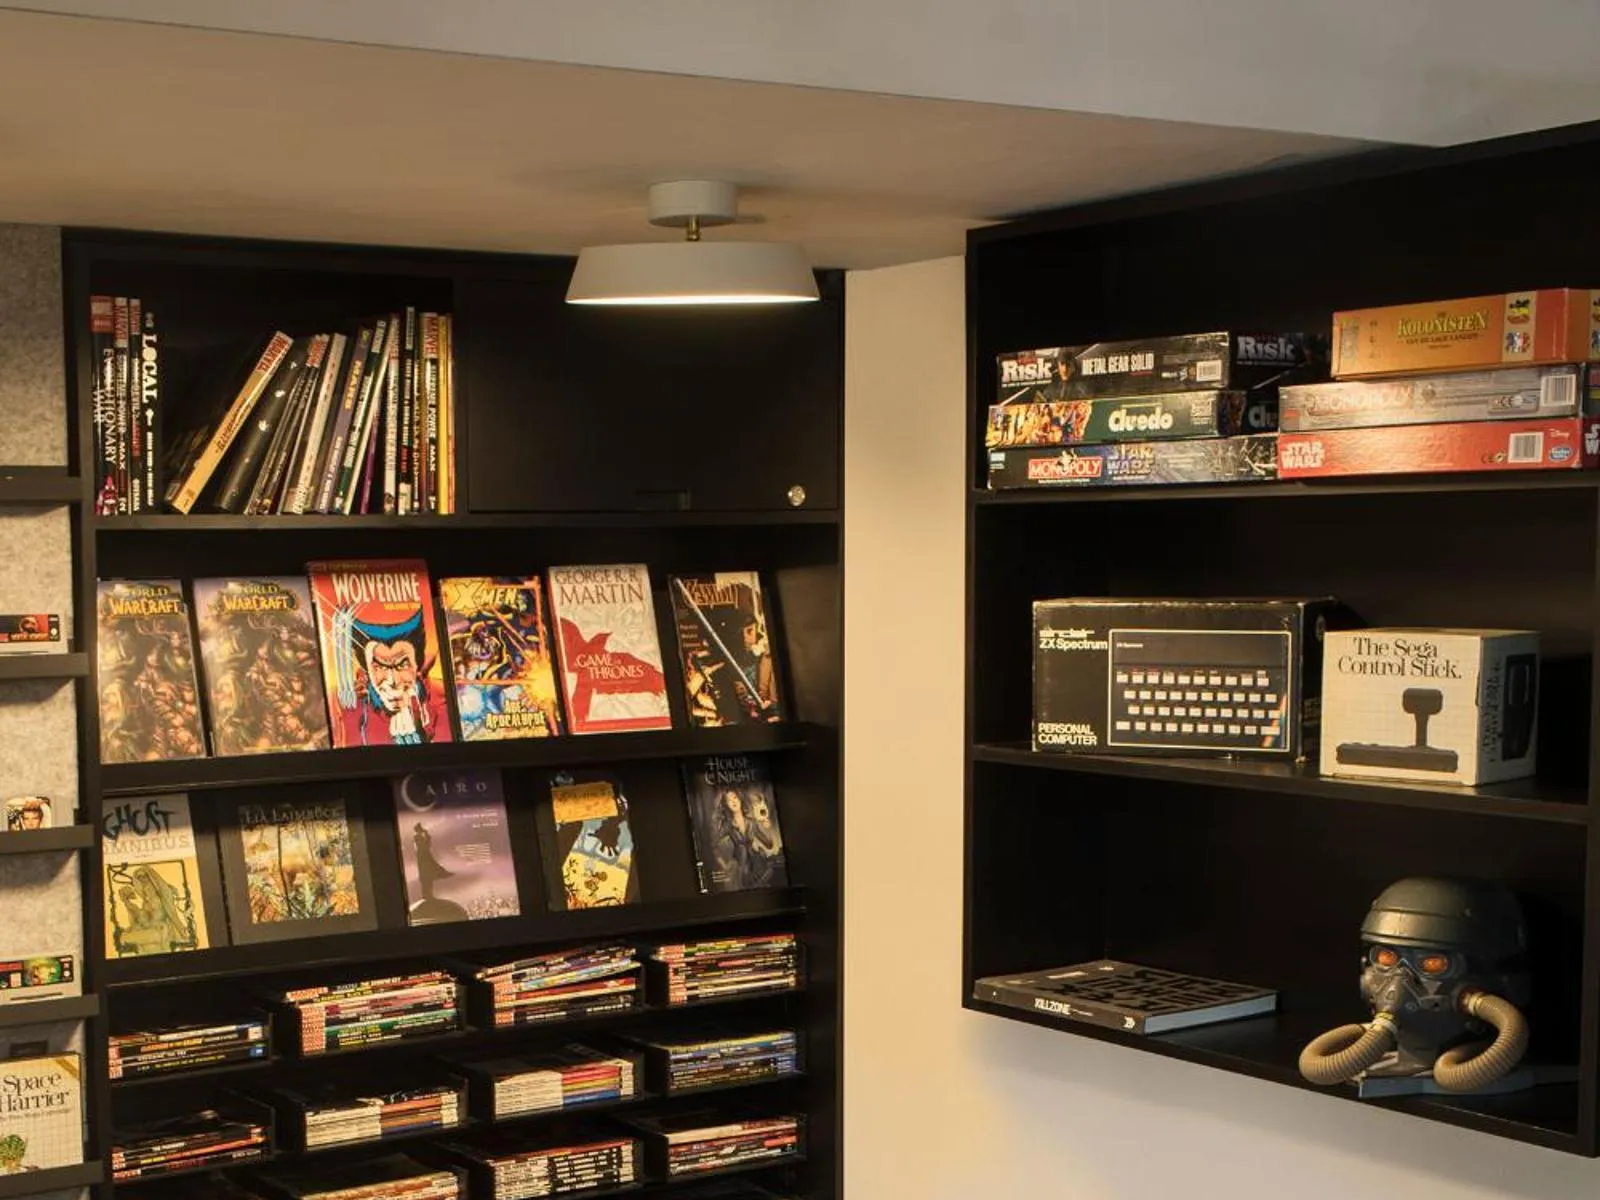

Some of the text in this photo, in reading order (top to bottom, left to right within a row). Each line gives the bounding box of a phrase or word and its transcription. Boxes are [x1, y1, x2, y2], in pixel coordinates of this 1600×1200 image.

[142, 333, 158, 403] LOCAL
[1082, 353, 1154, 376] METAL GEAR SOLID
[1108, 406, 1174, 433] Cluedo
[1287, 441, 1324, 455] STAR
[1029, 458, 1102, 478] MONOPOLY
[1281, 452, 1326, 469] WARS
[555, 570, 610, 585] GEORGE
[332, 573, 421, 607] WOLVERINE
[455, 582, 517, 611] X-MEN
[560, 583, 645, 606] MARTIN
[1039, 638, 1055, 649] ZX
[1056, 638, 1108, 651] Spectrum
[1353, 637, 1439, 660] The Sega
[576, 653, 613, 668] GAME
[1338, 656, 1406, 677] Control
[588, 665, 644, 680] THRONES
[1038, 723, 1094, 735] PERSONAL
[1038, 734, 1098, 746] COMPUTER
[1034, 998, 1070, 1016] KILLZONE
[3, 1074, 62, 1097] Space
